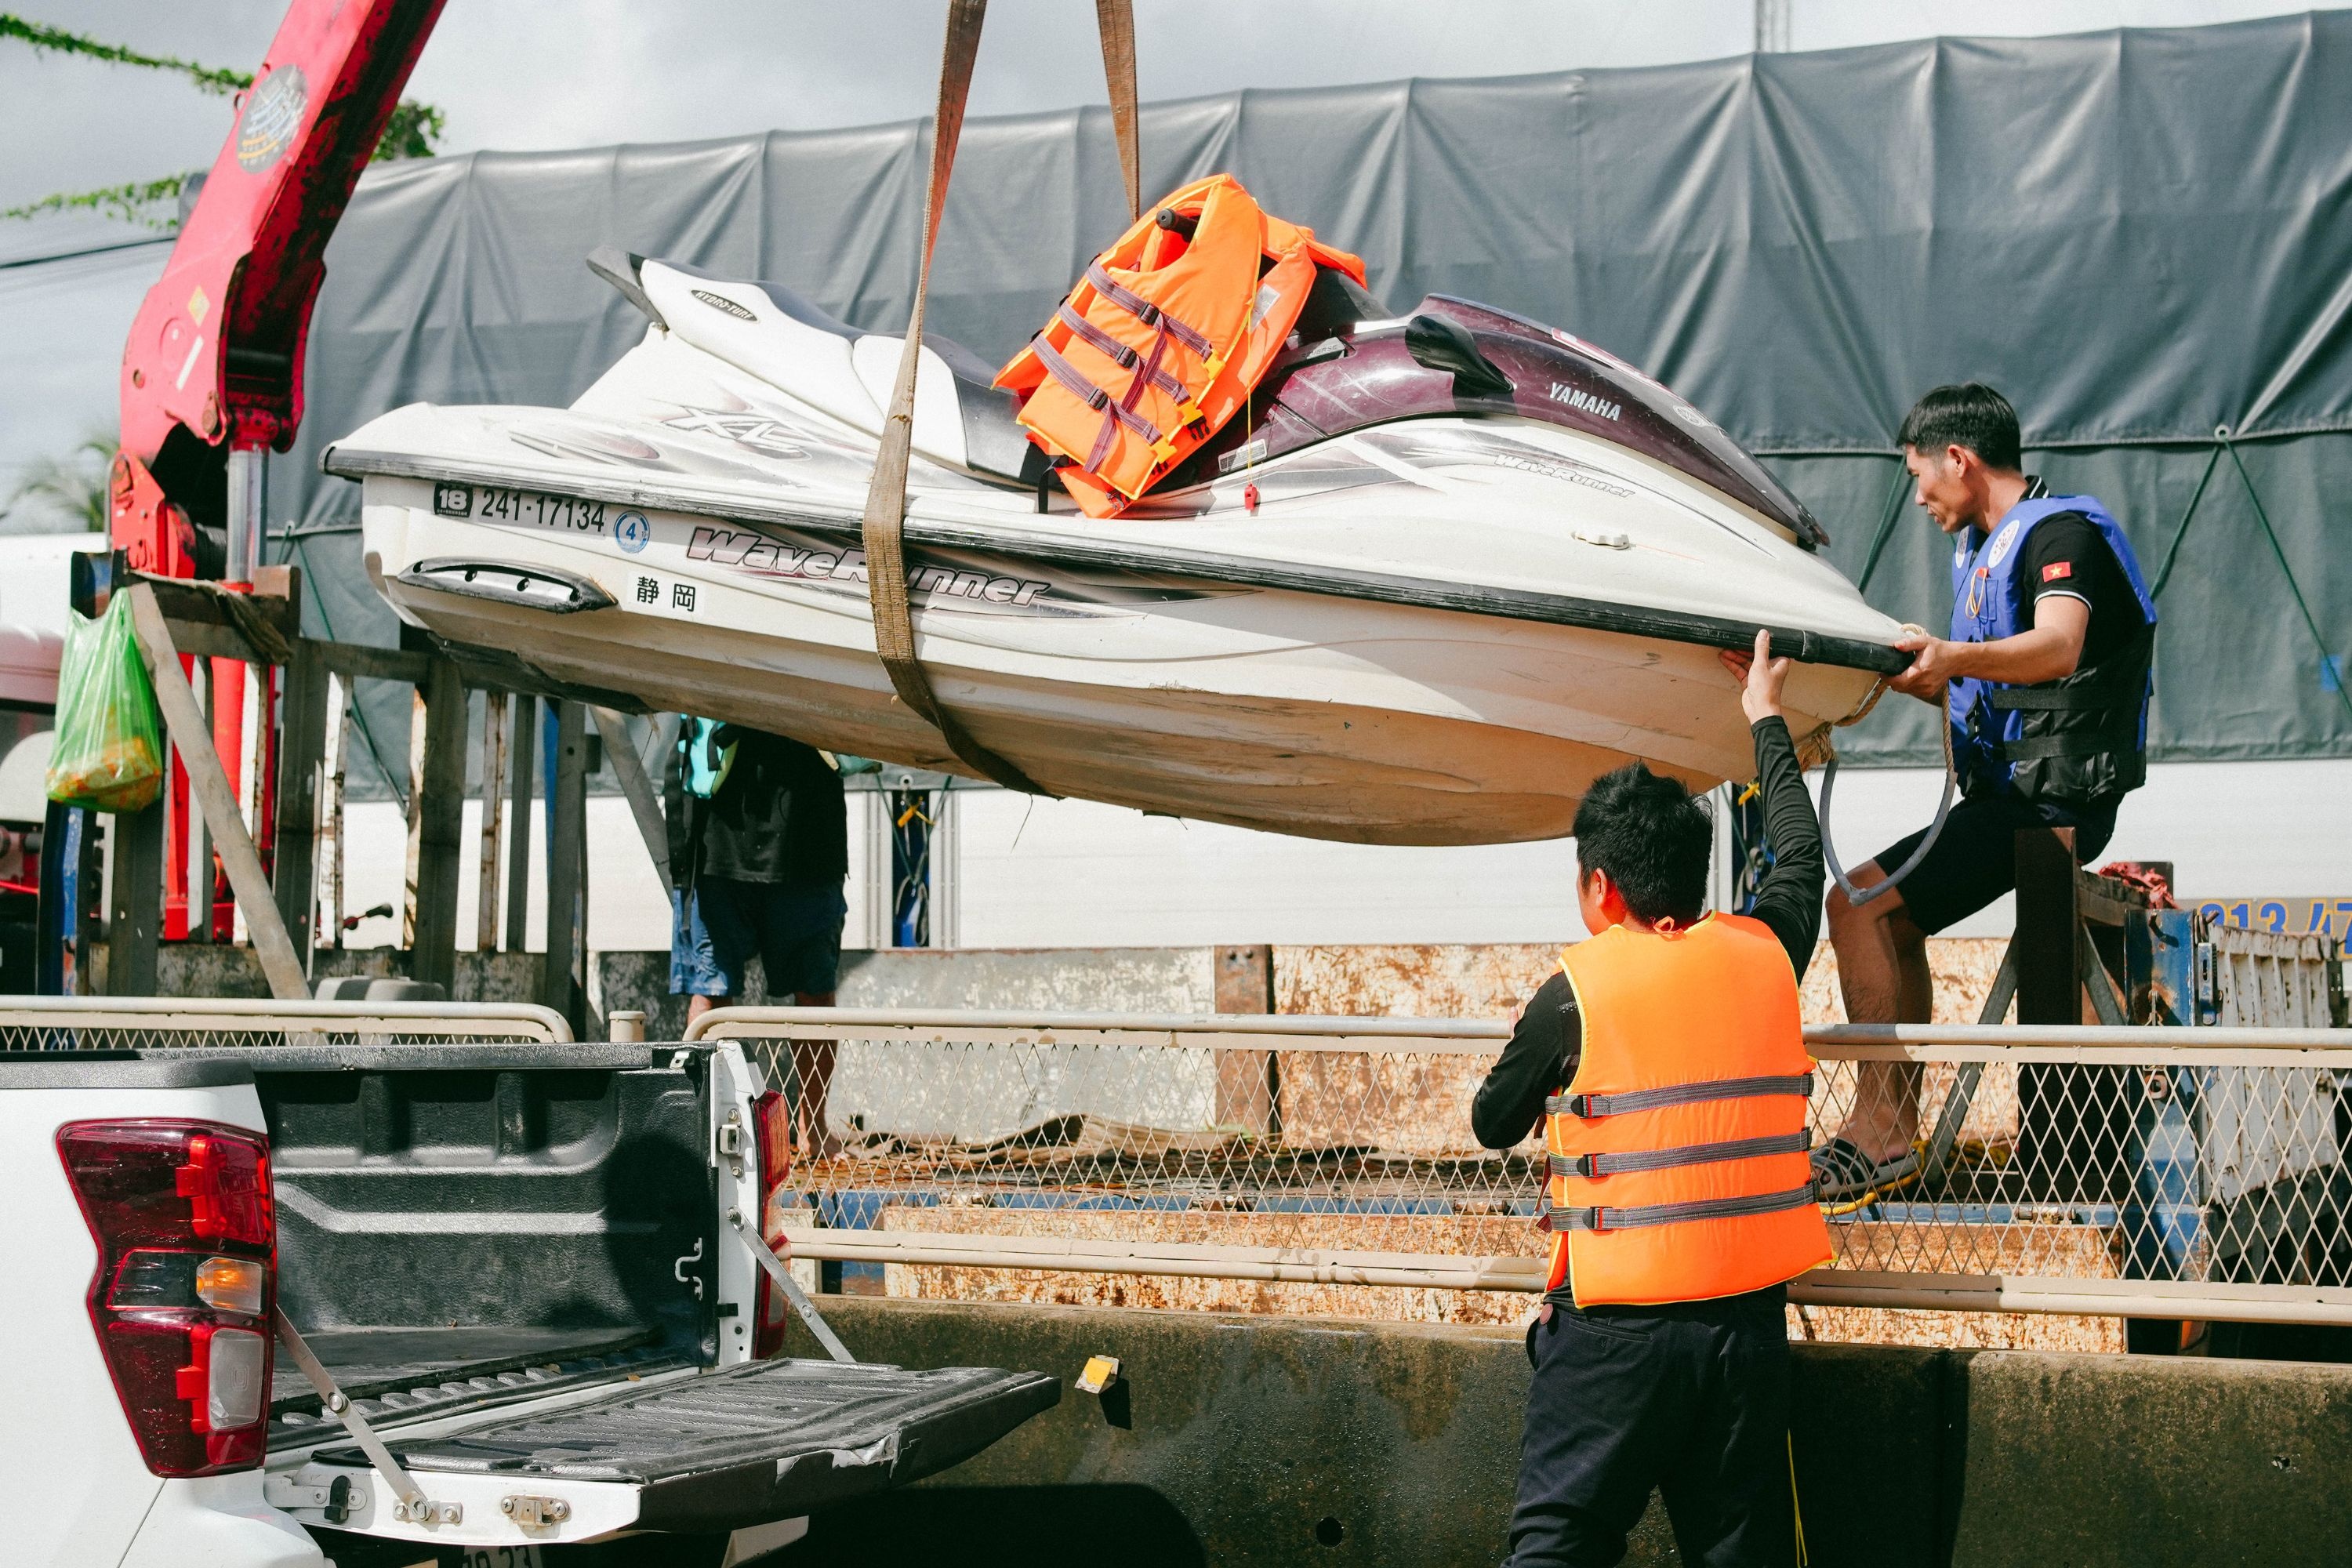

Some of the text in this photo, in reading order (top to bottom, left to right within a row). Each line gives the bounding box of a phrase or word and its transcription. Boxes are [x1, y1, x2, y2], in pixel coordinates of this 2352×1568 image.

[1549, 382, 1621, 422] YAMAHA
[661, 405, 806, 452] XL
[1494, 454, 1636, 499] WaveRunner
[439, 488, 606, 532] 18 241-17134
[626, 522, 636, 540] 4
[637, 575, 695, 612] 静岡
